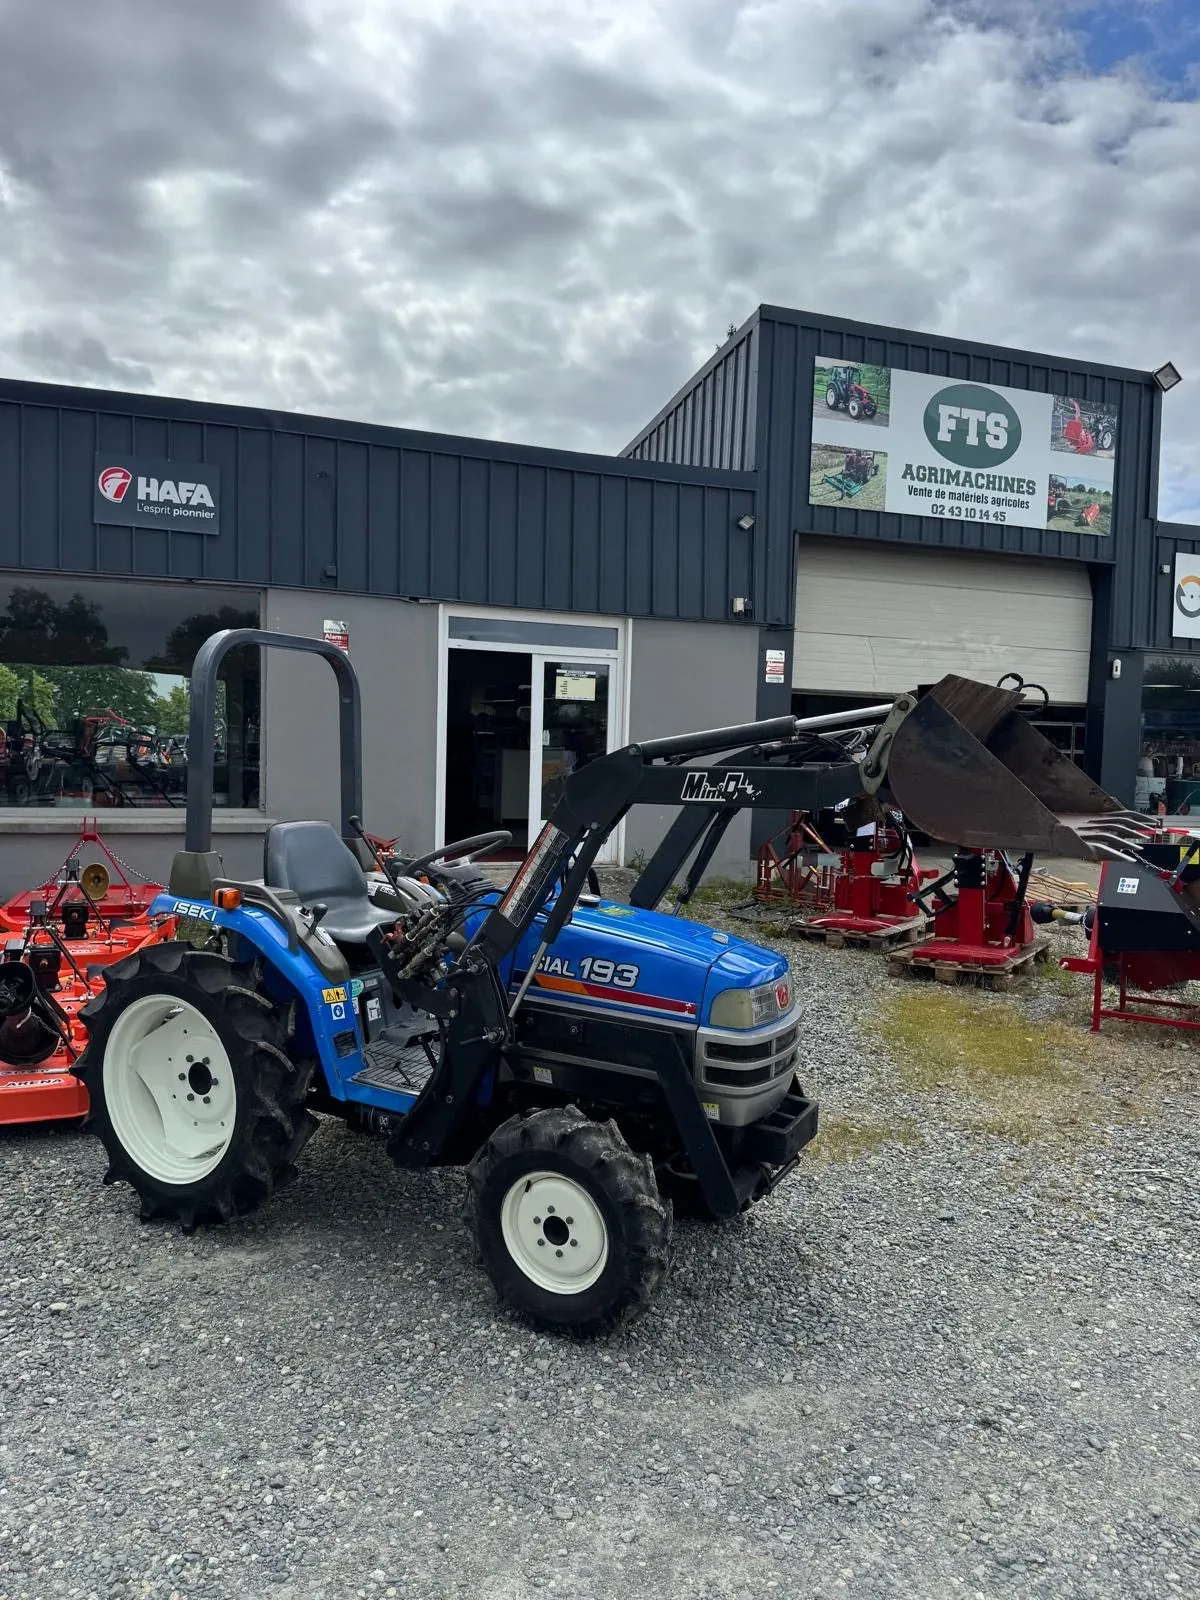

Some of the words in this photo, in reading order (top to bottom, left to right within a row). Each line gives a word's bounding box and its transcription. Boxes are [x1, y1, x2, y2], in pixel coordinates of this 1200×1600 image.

[937, 404, 1009, 450] FTS
[137, 476, 215, 508] HAFA
[901, 463, 1036, 496] AGRIMACHINES
[136, 502, 171, 515] L'esprit
[173, 507, 215, 519] pionnier
[908, 485, 932, 498] Vente
[935, 488, 946, 500] de
[948, 490, 988, 505] matériels
[991, 496, 1030, 509] agricoles
[931, 503, 945, 515] 02
[948, 505, 962, 517] 43
[964, 507, 976, 519] 10
[979, 509, 990, 520] 14
[992, 511, 1007, 522] 45
[172, 901, 218, 922] ISEKI
[580, 957, 640, 988] 193
